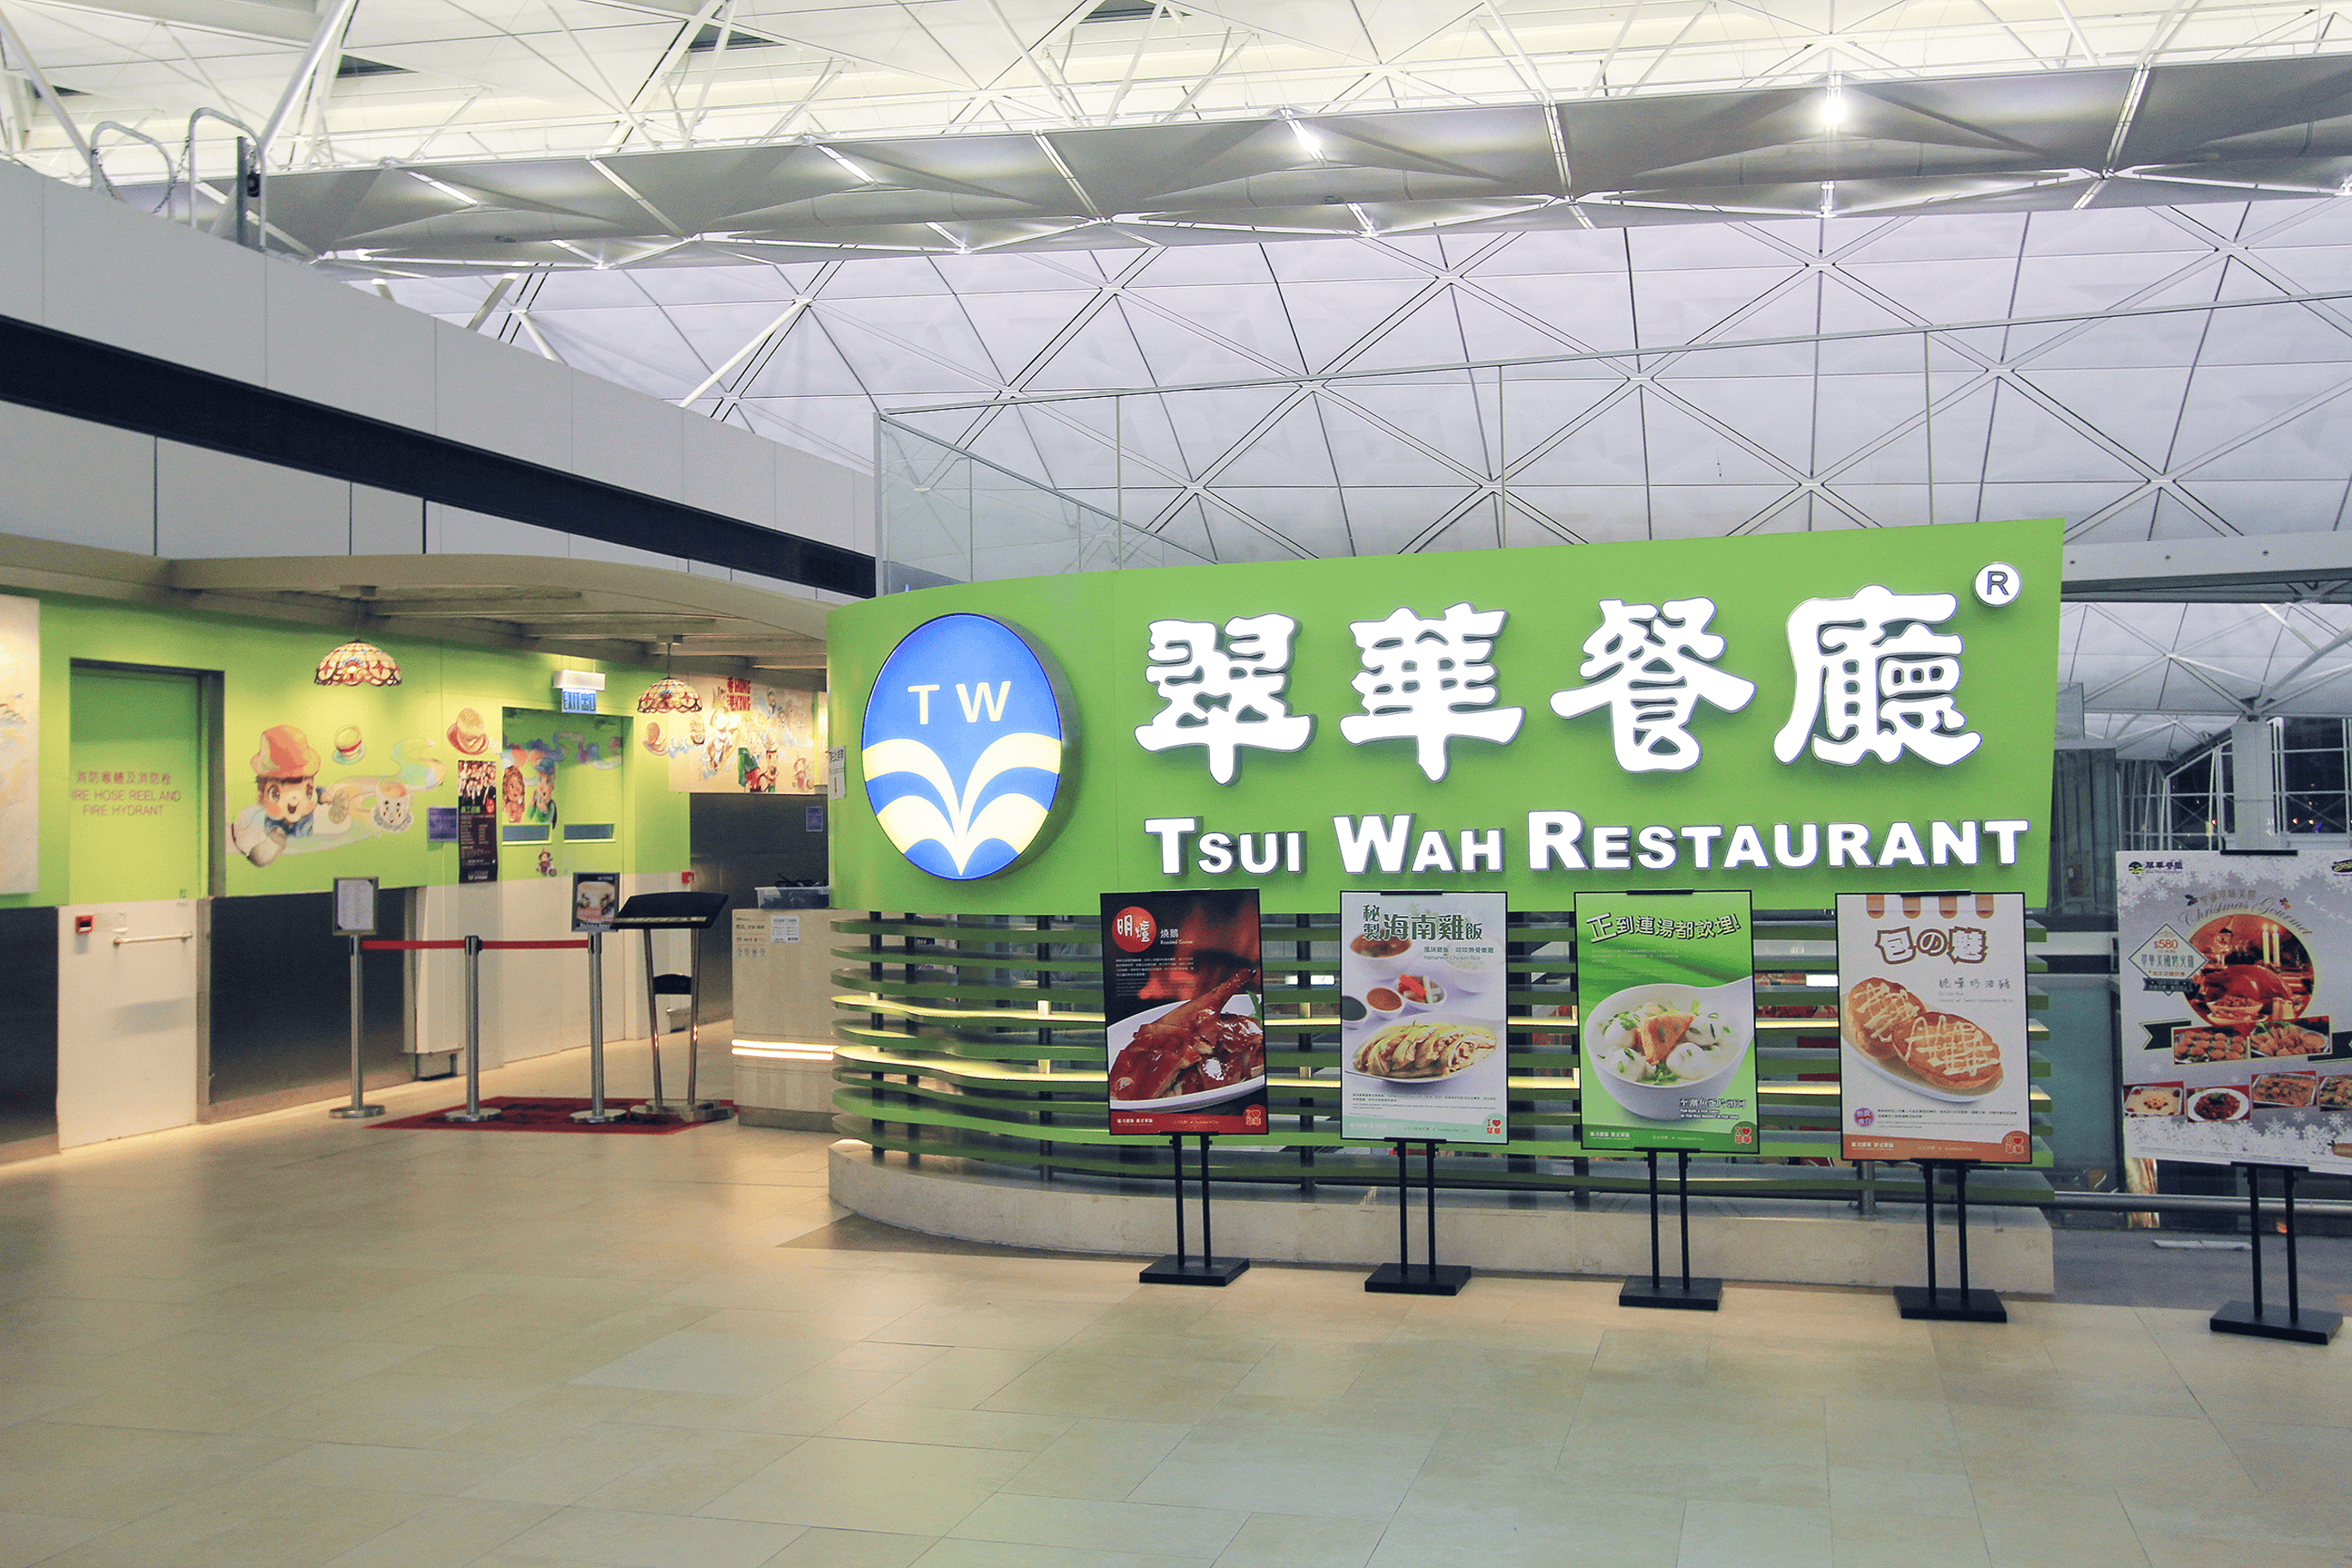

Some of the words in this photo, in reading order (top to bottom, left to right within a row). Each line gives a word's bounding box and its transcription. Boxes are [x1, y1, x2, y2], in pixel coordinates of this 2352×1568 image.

[1134, 584, 1982, 784] 翠華餐廳
[563, 692, 580, 711] EXIT
[95, 790, 125, 802] HOSE
[129, 790, 157, 801] REEL
[159, 790, 181, 802] AND
[82, 804, 107, 815] FIRE
[112, 804, 164, 815] HYDRANT
[2178, 901, 2249, 926] Christmas
[2251, 897, 2312, 935] Gourmet
[1383, 913, 1482, 941] 海南雞飯
[2153, 939, 2178, 949] $580
